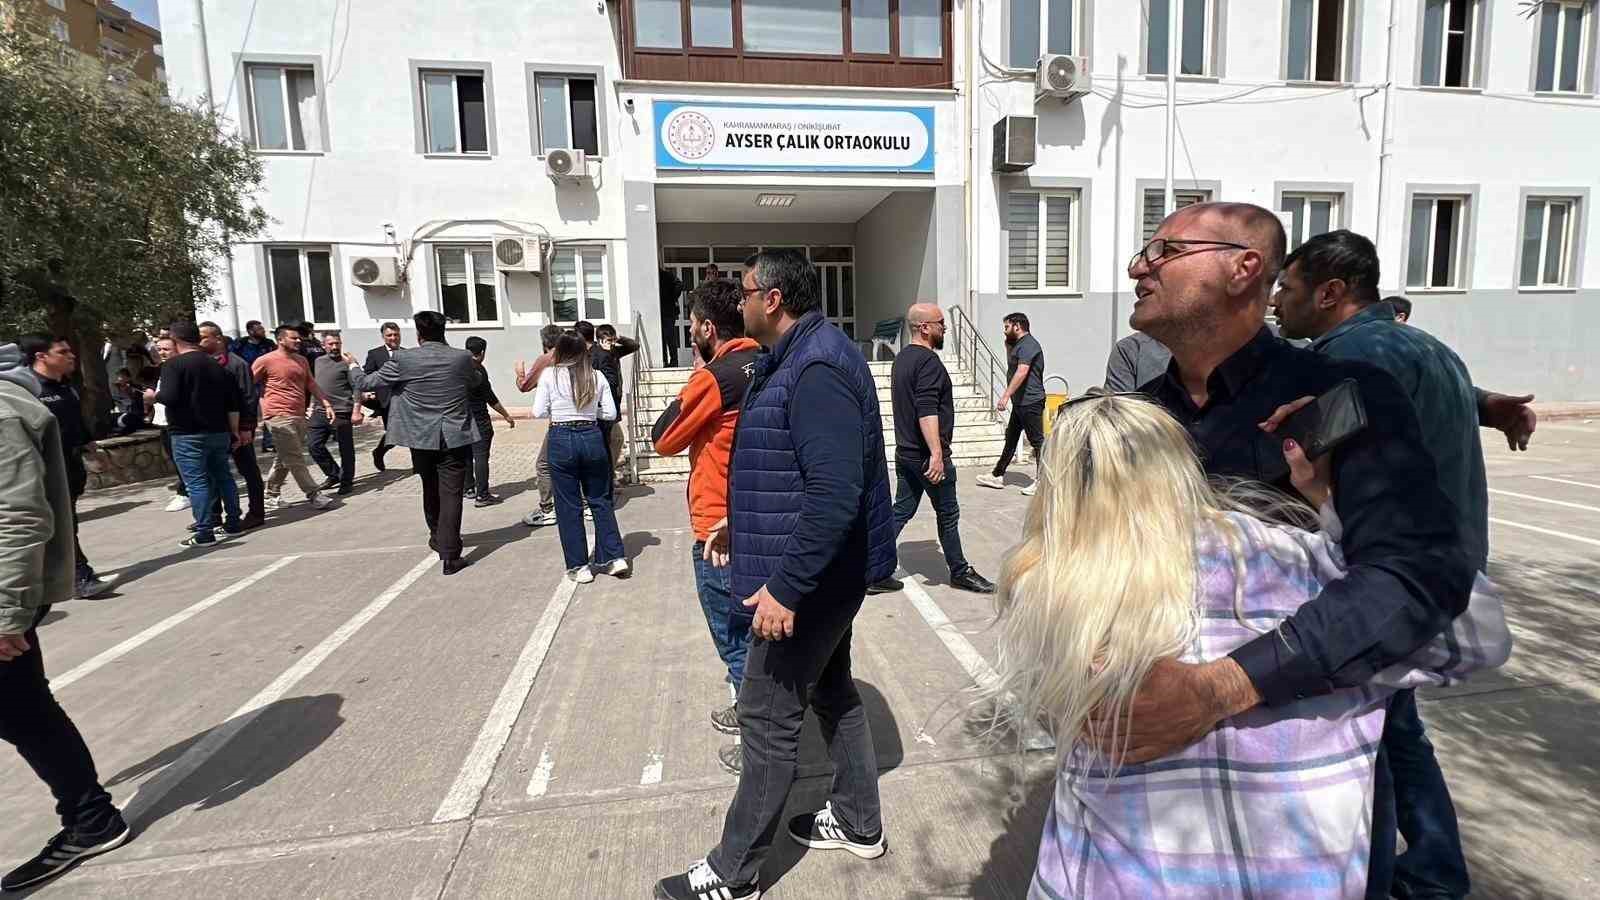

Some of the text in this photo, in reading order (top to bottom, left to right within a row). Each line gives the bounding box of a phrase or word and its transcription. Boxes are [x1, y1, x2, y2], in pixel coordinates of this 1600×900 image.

[723, 121, 792, 131] KAHRAMANMARAŞ
[725, 133, 773, 148] AYSER
[776, 134, 820, 151] ÇALIK
[823, 135, 911, 150] ORTAOKULU
